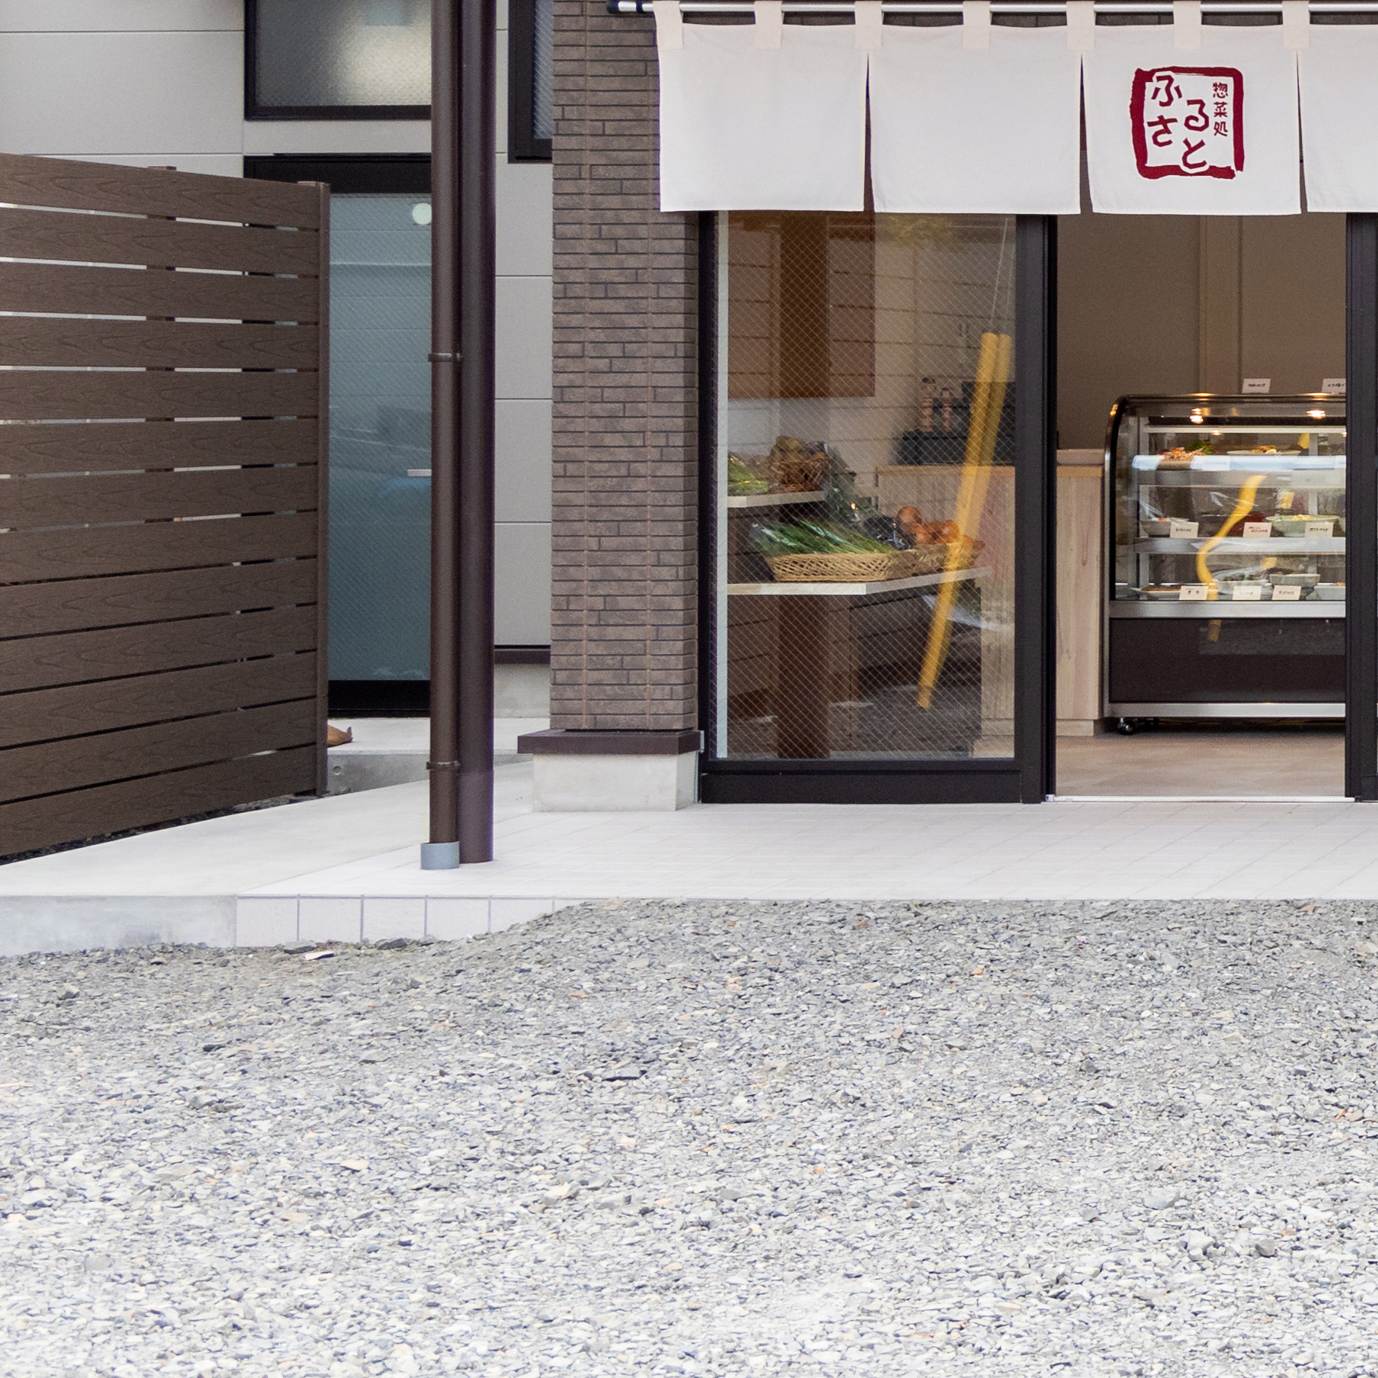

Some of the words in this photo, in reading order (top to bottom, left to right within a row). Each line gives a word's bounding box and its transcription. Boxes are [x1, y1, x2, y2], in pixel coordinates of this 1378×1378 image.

[1146, 74, 1210, 170] ふるさと
[1212, 81, 1229, 137] 惣菜処
